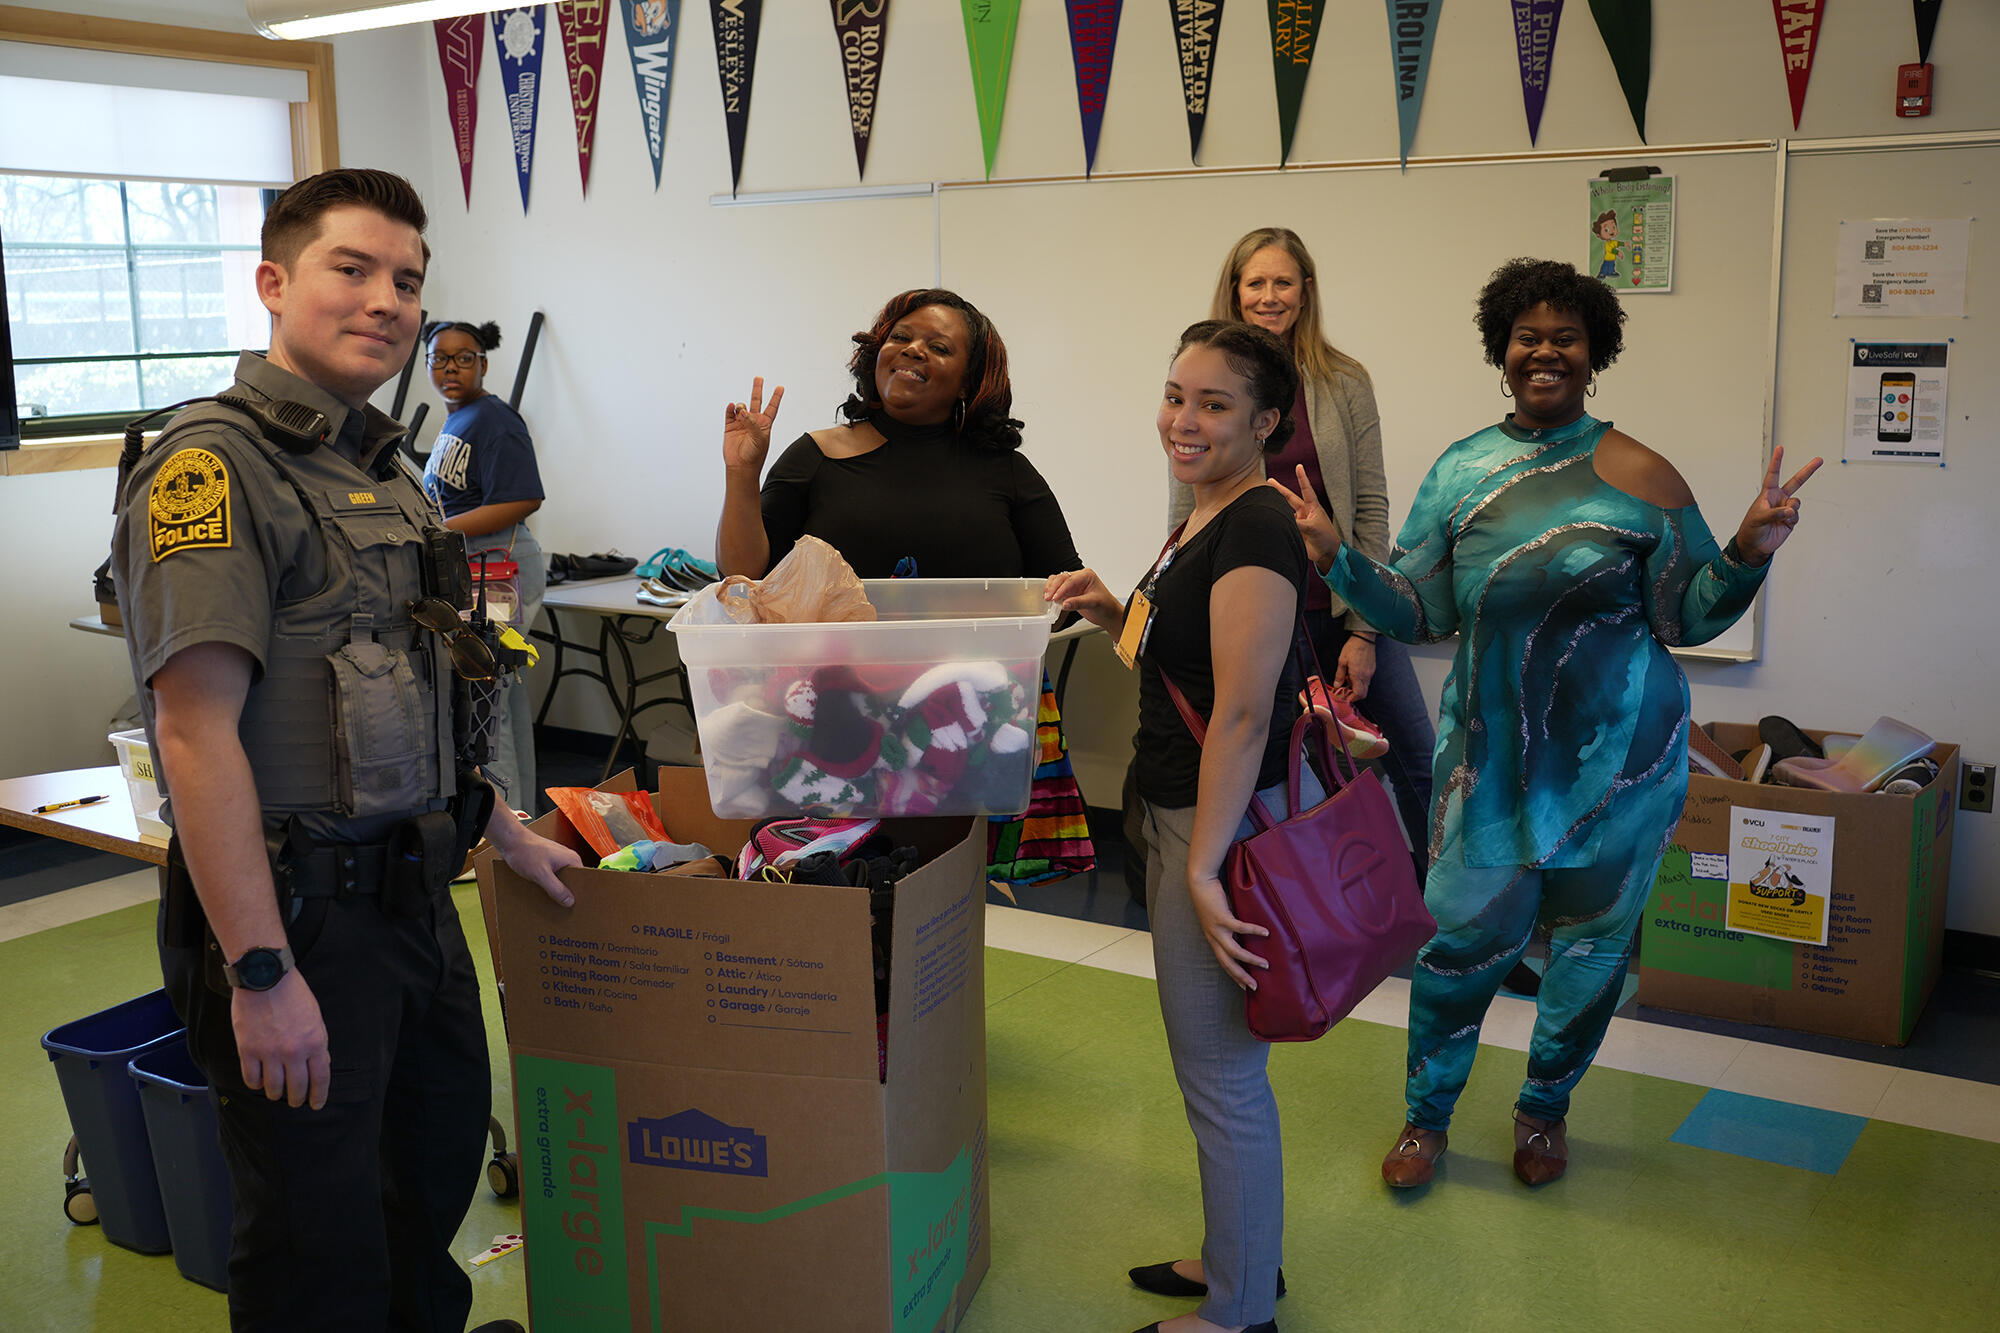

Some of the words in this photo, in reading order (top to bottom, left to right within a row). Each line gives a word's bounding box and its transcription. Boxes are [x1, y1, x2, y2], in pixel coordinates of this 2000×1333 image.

[1396, 0, 1429, 101] ROLINA
[1533, 11, 1553, 91] POINT
[574, 0, 604, 157] ELON
[842, 30, 862, 135] COLLEGE
[860, 24, 880, 138] ROANOKE
[1904, 70, 1924, 79] FIRE
[518, 71, 536, 131] CHRISTOPHER
[633, 36, 670, 159] Wingate
[1094, 93, 1105, 113] OF
[508, 93, 521, 153] UNIVERSITY
[520, 132, 532, 174] NEWPORT
[1592, 185, 1614, 198] Whole
[1616, 183, 1636, 193] Body
[1869, 351, 1900, 359] LiveSafe
[155, 451, 221, 488] COMMONWEALTH
[182, 479, 225, 520] UNIVERSITY
[155, 523, 223, 553] POLICE
[1749, 819, 1765, 827] VCU
[1776, 841, 1818, 857] Drive
[1755, 886, 1798, 898] SUPPORT
[1655, 916, 1690, 937] extra
[1694, 923, 1745, 943] grande
[1845, 925, 1871, 935] Room
[1846, 915, 1872, 924] Room
[643, 925, 693, 940] FRAGILE
[702, 932, 730, 944] Frágil
[549, 935, 599, 950] Bedroom
[607, 943, 659, 957] Dormitorio
[551, 951, 586, 966] Family
[589, 955, 620, 968] Room
[629, 961, 651, 972] Sala
[652, 963, 689, 975] familiar
[716, 951, 776, 966] Basement
[786, 958, 824, 969] Sótano
[1812, 964, 1834, 973] Attic
[1813, 953, 1858, 965] Basement
[551, 966, 587, 982] Dining
[589, 970, 620, 984] Room
[629, 976, 675, 989] Comedor
[717, 967, 746, 980] Attic
[756, 971, 782, 982] Ático
[1812, 974, 1849, 986] Laundry
[552, 981, 595, 996] Kitchen
[603, 989, 638, 1001] Cocina
[718, 983, 768, 998] Laundry
[1811, 983, 1845, 996] Garage
[554, 997, 580, 1009] Bath
[589, 1002, 613, 1013] Baño
[719, 998, 765, 1013] Garage
[775, 1003, 810, 1016] Garaje
[536, 1087, 550, 1132] extra
[642, 1128, 754, 1169] LOWE'S
[537, 1135, 558, 1199] grande
[561, 1084, 609, 1277] x-large
[907, 1186, 967, 1283] x-large
[902, 1286, 926, 1320] extra
[926, 1247, 952, 1291] grande
